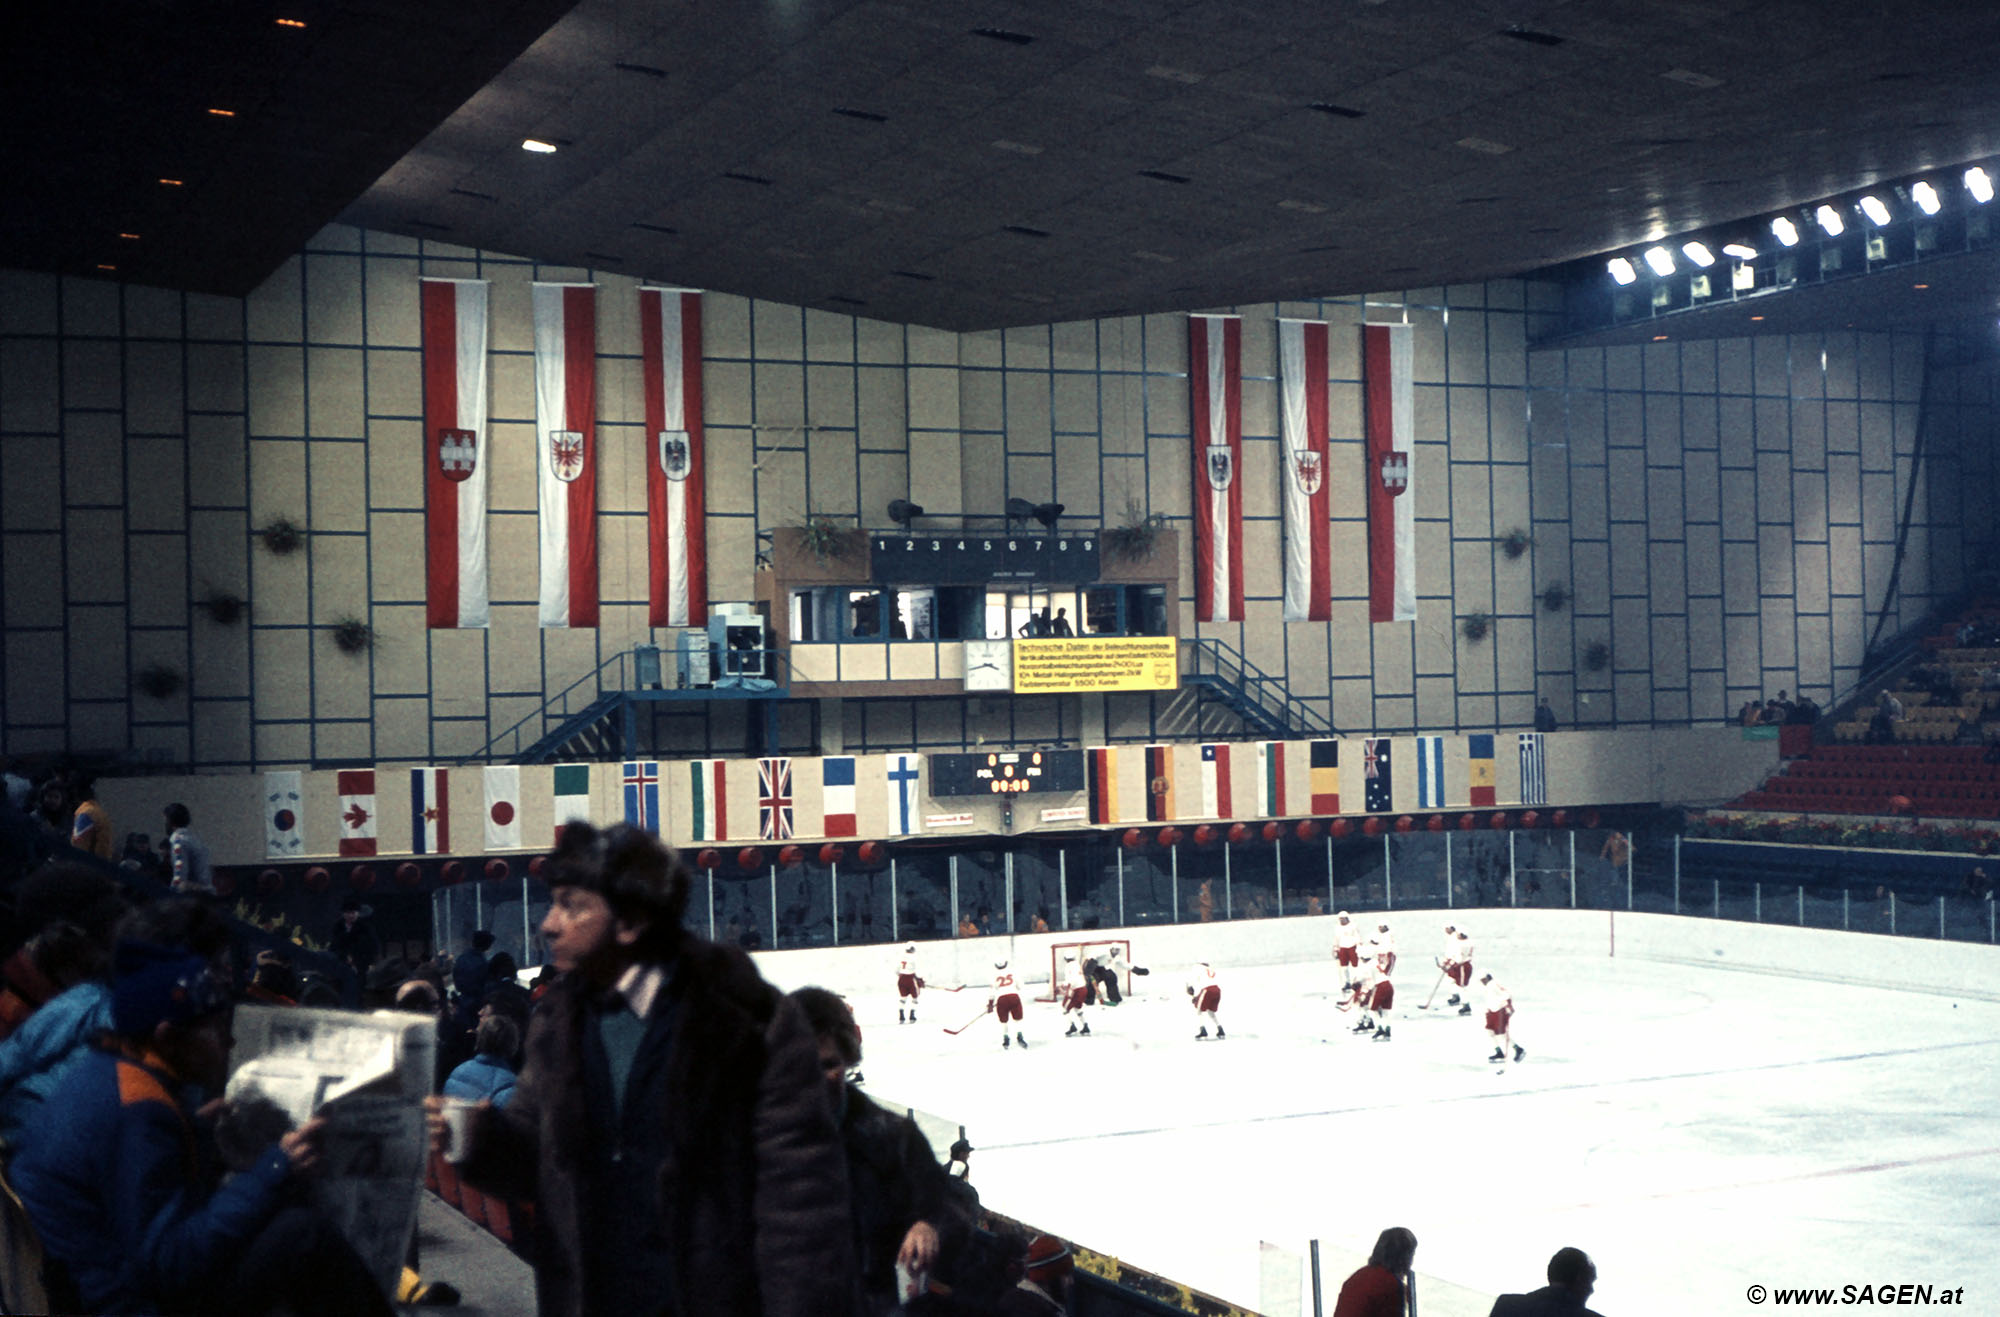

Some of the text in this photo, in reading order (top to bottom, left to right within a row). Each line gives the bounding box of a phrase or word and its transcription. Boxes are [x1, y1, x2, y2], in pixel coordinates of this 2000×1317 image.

[879, 540, 1092, 551] 1 2 3 4 5 6 7 8 9
[988, 753, 997, 767] 0
[1032, 751, 1042, 766] 0
[1004, 764, 1014, 778] 0
[991, 779, 1030, 793] 00:00
[900, 961, 908, 969] 7
[996, 974, 1014, 987] 25
